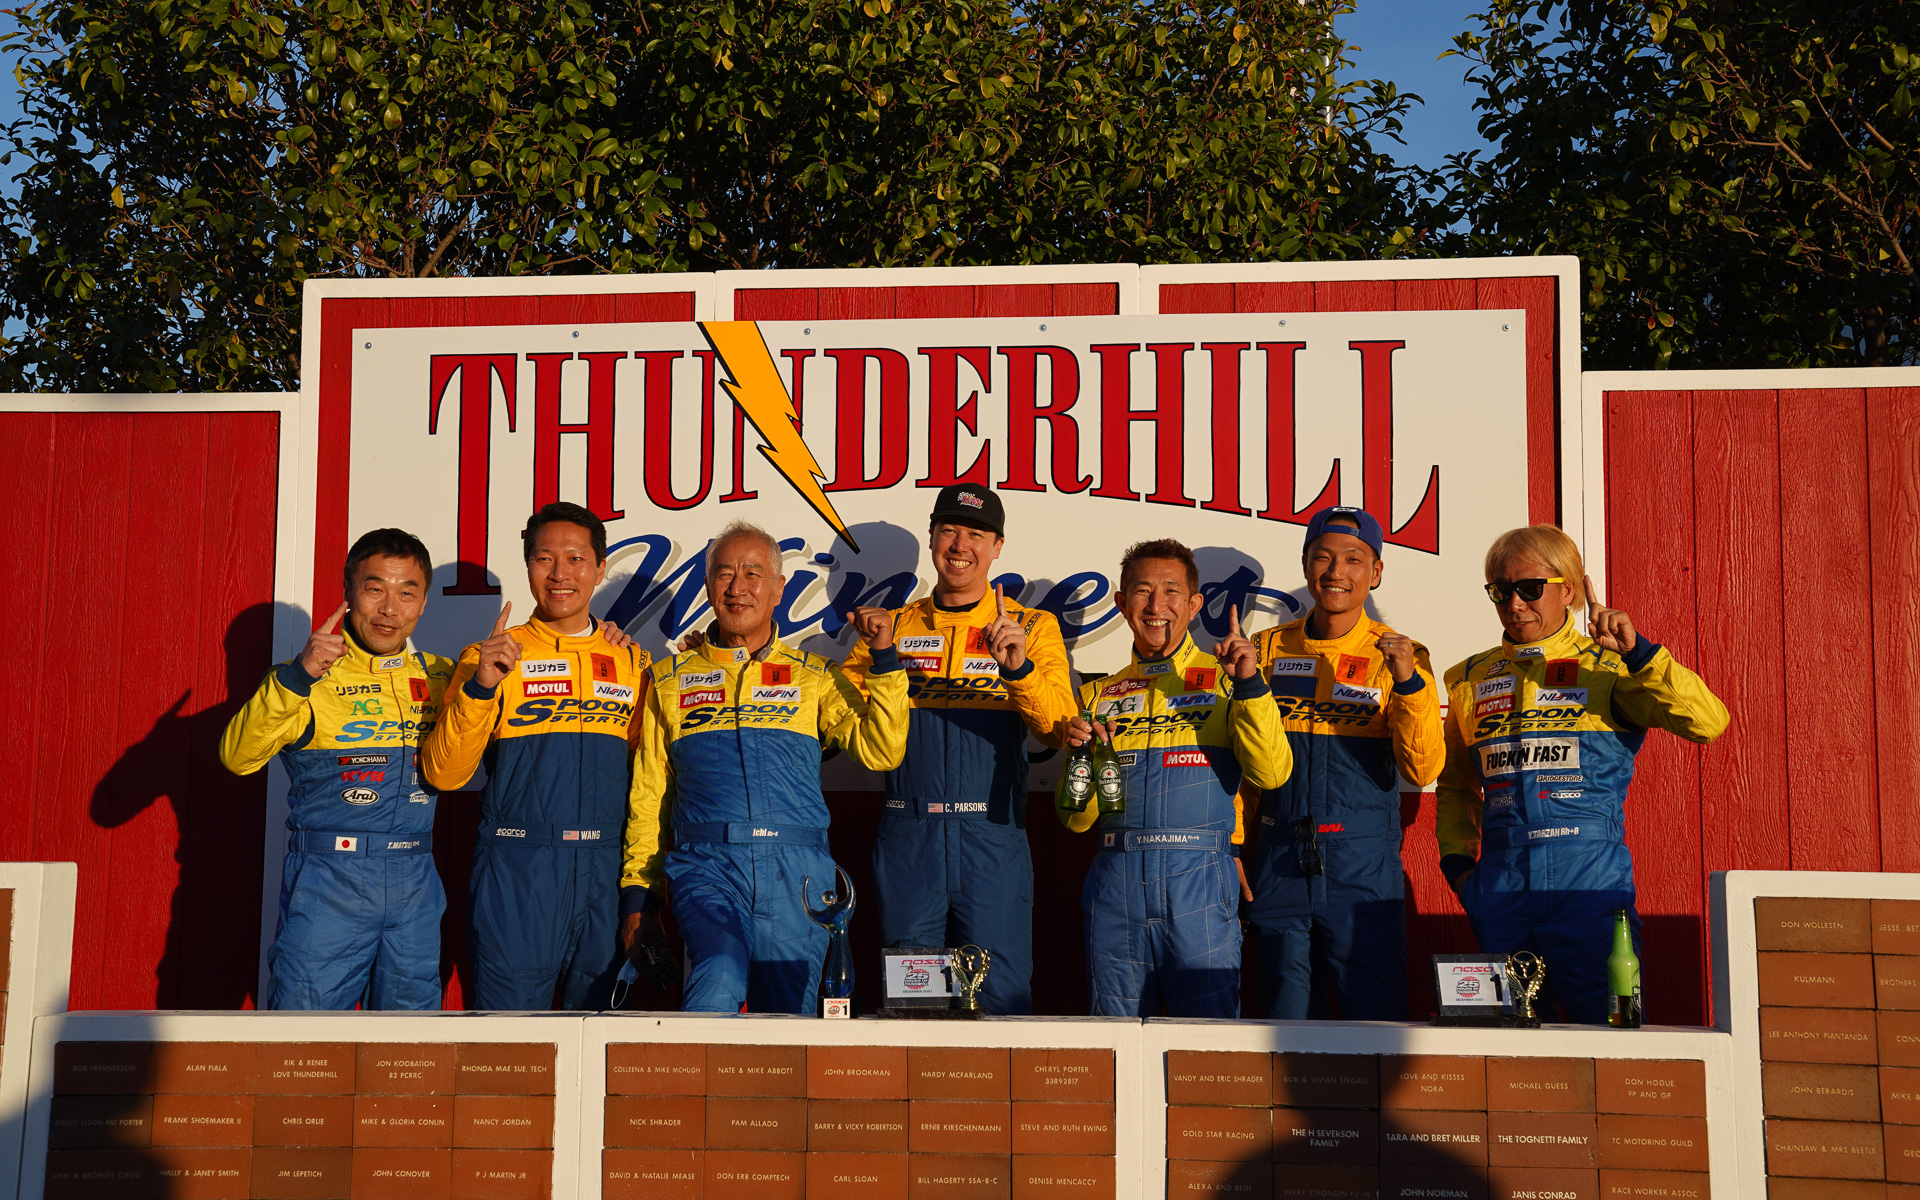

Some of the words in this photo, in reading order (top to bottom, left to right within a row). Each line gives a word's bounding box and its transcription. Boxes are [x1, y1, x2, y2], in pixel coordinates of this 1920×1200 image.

[428, 339, 1440, 597] THUNDERHILL
[904, 640, 940, 650] リジカラ
[527, 663, 567, 674] リジカラ
[902, 659, 939, 669] MOTUL
[964, 660, 1000, 671] NISSI
[1278, 661, 1313, 671] リジカラ
[685, 672, 722, 684] リジカラ
[336, 683, 382, 696] リジカラ
[526, 683, 570, 695] MOTUL
[1480, 680, 1513, 695] リジカラ
[682, 691, 723, 706] MOTUL
[918, 692, 1006, 701] SPORTS
[350, 698, 383, 715] AG
[1106, 697, 1137, 716] AG
[1275, 697, 1380, 718] SPOON
[1477, 698, 1513, 714] MOTUL
[508, 698, 634, 727] SPOON
[680, 704, 799, 729] SPOON
[549, 715, 627, 727] SPORTS
[710, 719, 790, 728] SPORTS
[1114, 710, 1212, 737] SPOON
[1288, 713, 1368, 726] SPORTS
[1475, 706, 1587, 739] SPOON
[1124, 725, 1203, 737] SPORTS
[1498, 721, 1577, 733] SPORTS
[350, 755, 387, 764] YOKOHAMA
[1166, 753, 1207, 765] MOTUL
[1533, 745, 1571, 763] FAST
[341, 771, 385, 782] KYB
[945, 803, 952, 812] C.
[954, 803, 987, 812] PARSONS
[496, 828, 526, 839] sparco
[580, 830, 601, 840] WANG
[1137, 833, 1187, 844] Y.NAKAJIMA
[1528, 828, 1560, 839] Y.TARZAN
[940, 966, 953, 993] 1
[1490, 974, 1503, 1002] 1
[843, 1005, 848, 1016] 1
[1432, 1134, 1450, 1142] BRET
[1558, 1136, 1587, 1144] FAMILY
